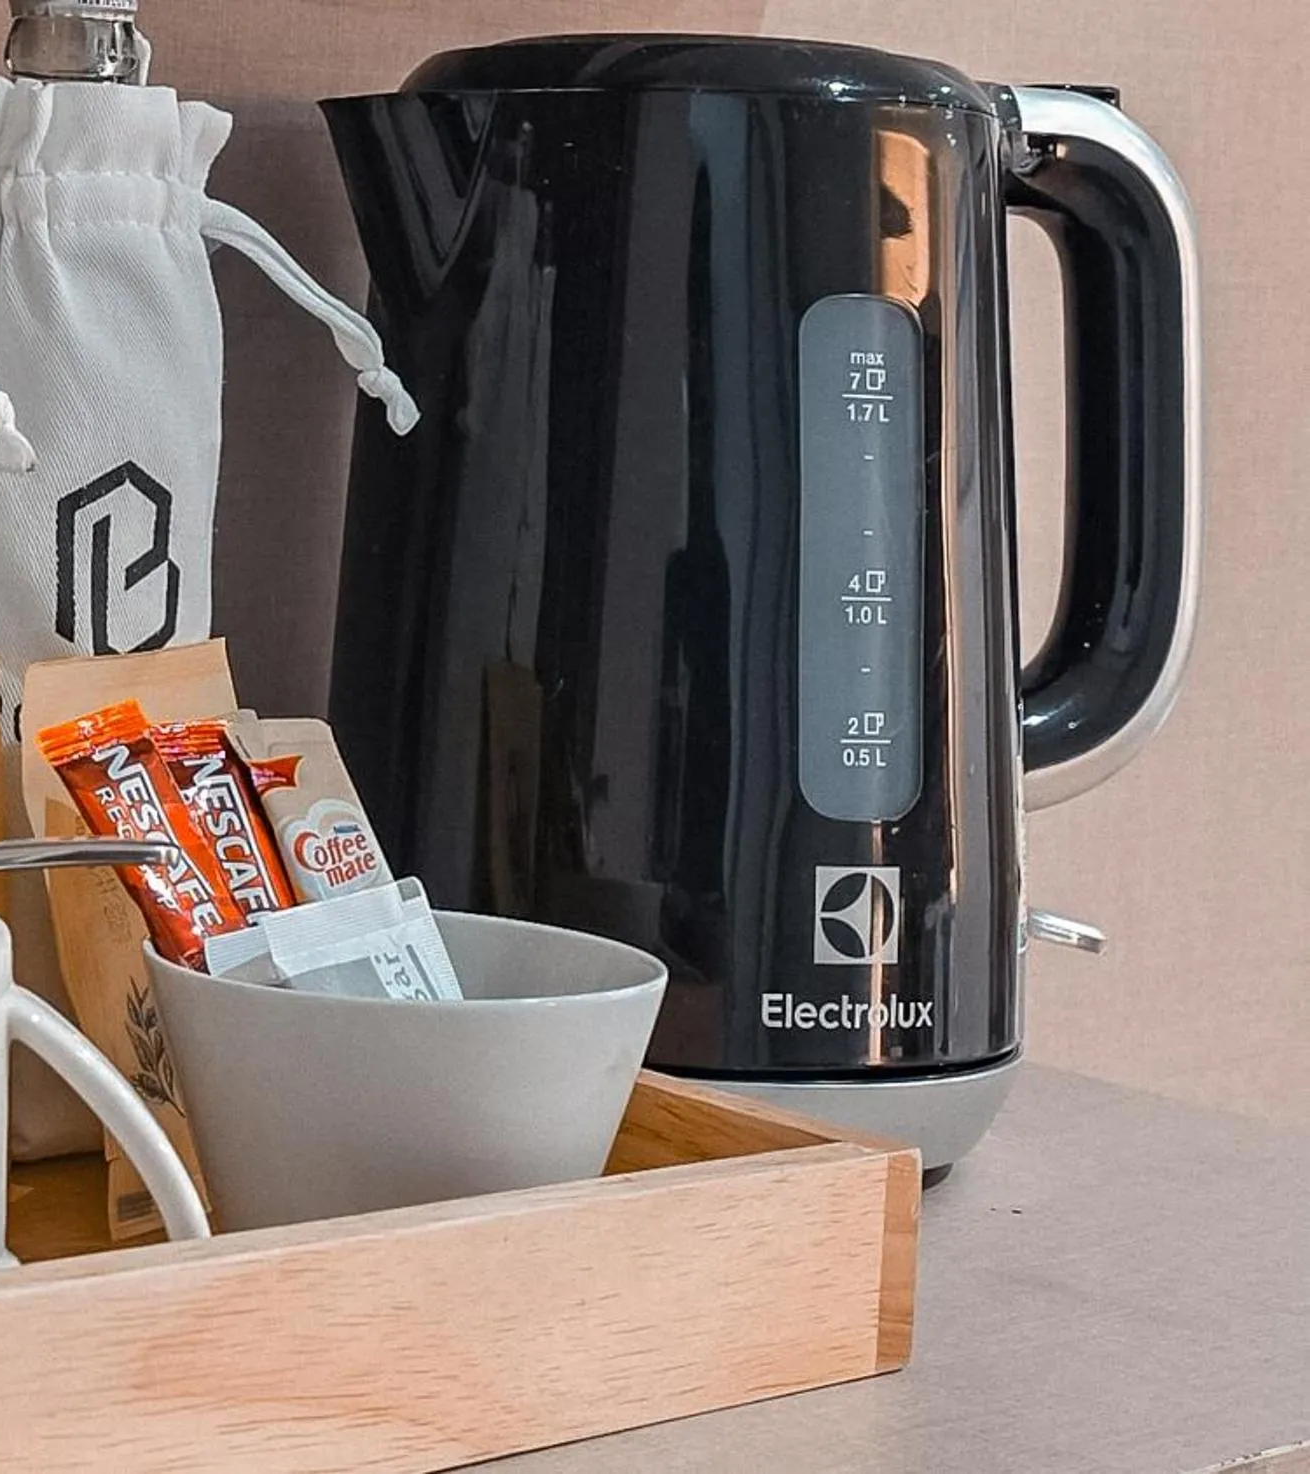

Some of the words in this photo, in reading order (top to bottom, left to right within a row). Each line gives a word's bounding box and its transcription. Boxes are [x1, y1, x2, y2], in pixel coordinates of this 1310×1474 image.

[850, 352, 884, 366] max
[849, 372, 861, 390] 7
[847, 403, 874, 422] 1.7
[878, 403, 890, 423] L
[848, 574, 861, 593] 4
[845, 605, 873, 624] 1.0
[877, 605, 888, 625] L
[848, 717, 860, 735] 2
[842, 748, 871, 766] 0.5
[875, 747, 887, 767] L
[184, 754, 279, 927] NESCAF
[293, 831, 368, 873] Coffee
[325, 851, 378, 888] mate
[760, 992, 934, 1030] Electrolux
